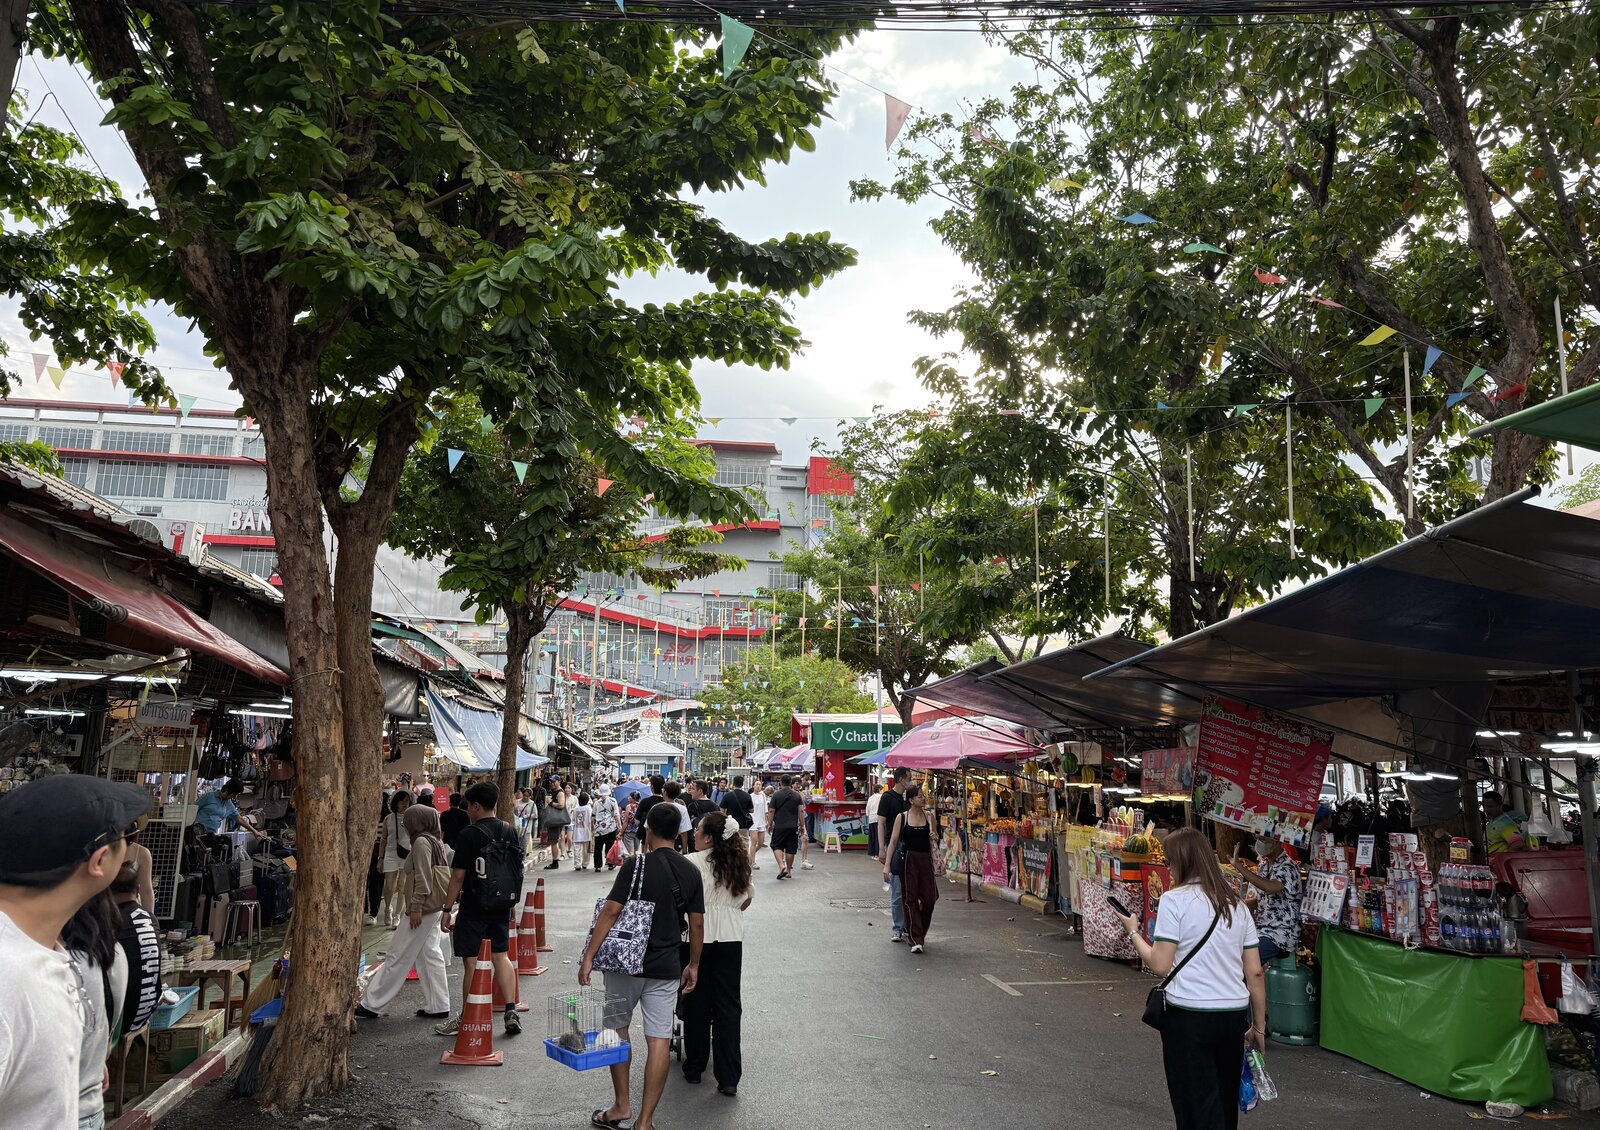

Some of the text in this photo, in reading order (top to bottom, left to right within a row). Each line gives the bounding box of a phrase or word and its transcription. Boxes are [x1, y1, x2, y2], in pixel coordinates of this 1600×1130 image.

[1217, 710, 1250, 728] Antique
[1251, 721, 1277, 735] coffee
[845, 731, 904, 742] Chatucha
[462, 1023, 492, 1033] GUARD
[469, 1037, 482, 1046] 24
